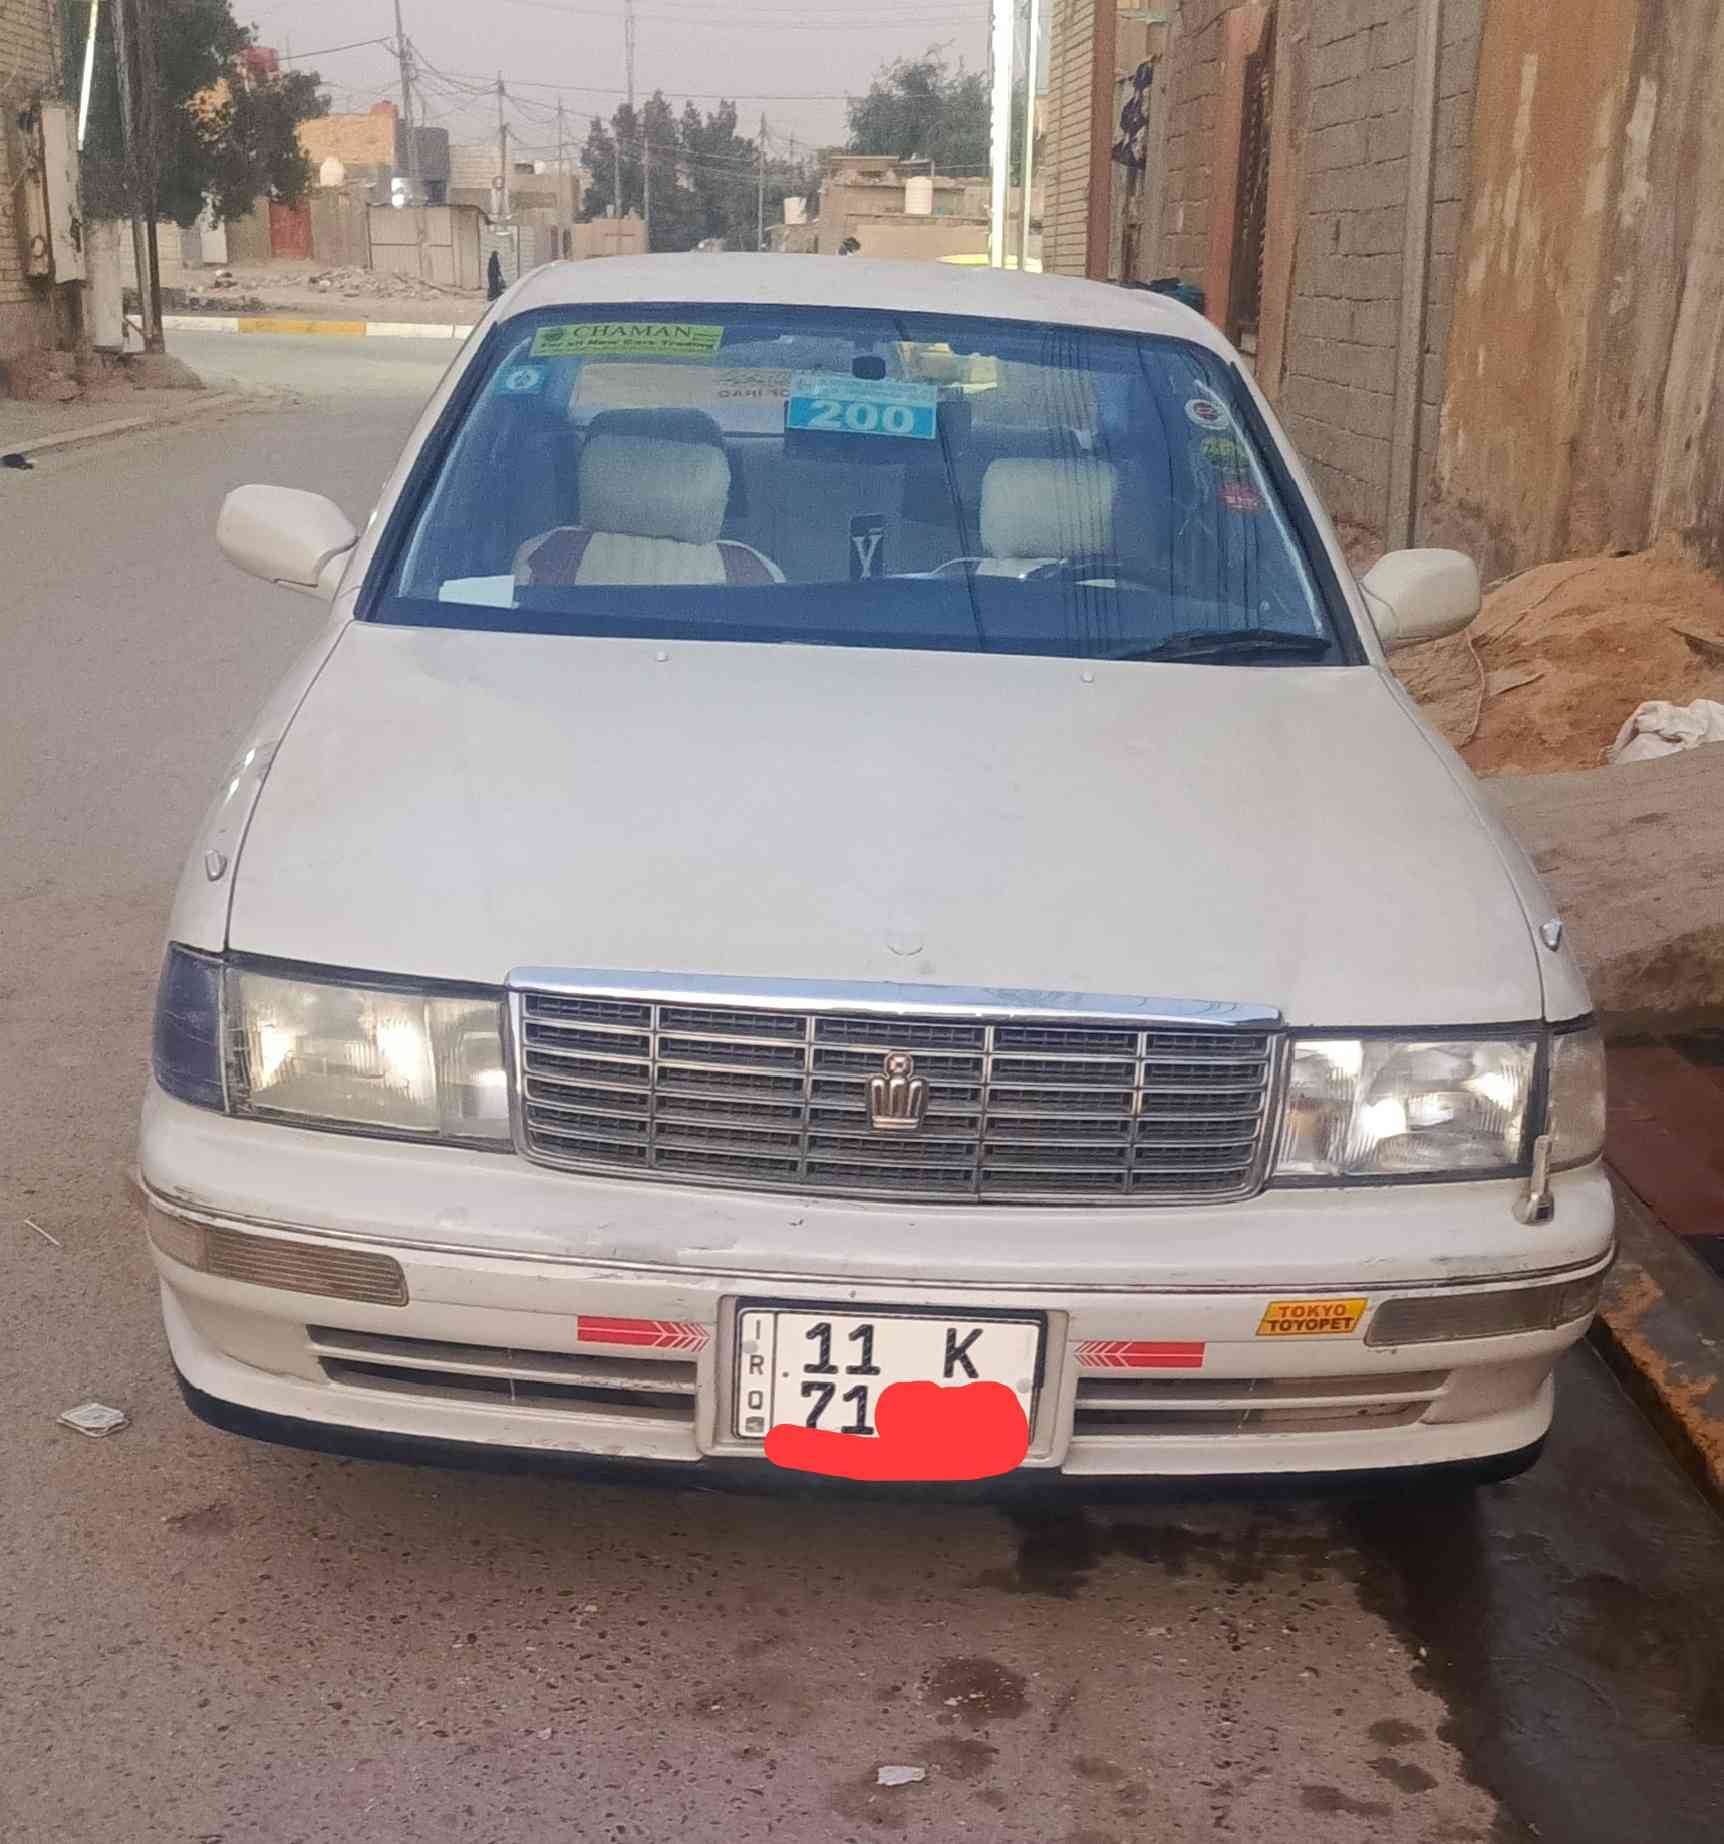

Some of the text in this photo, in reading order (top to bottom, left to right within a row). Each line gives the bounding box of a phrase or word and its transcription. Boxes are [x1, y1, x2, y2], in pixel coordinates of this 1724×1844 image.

[574, 325, 690, 337] CHAMAN
[808, 401, 914, 433] 200
[1278, 1304, 1347, 1318] TOKYO
[1267, 1317, 1354, 1331] TOYOPET
[803, 1322, 983, 1379] 11 K
